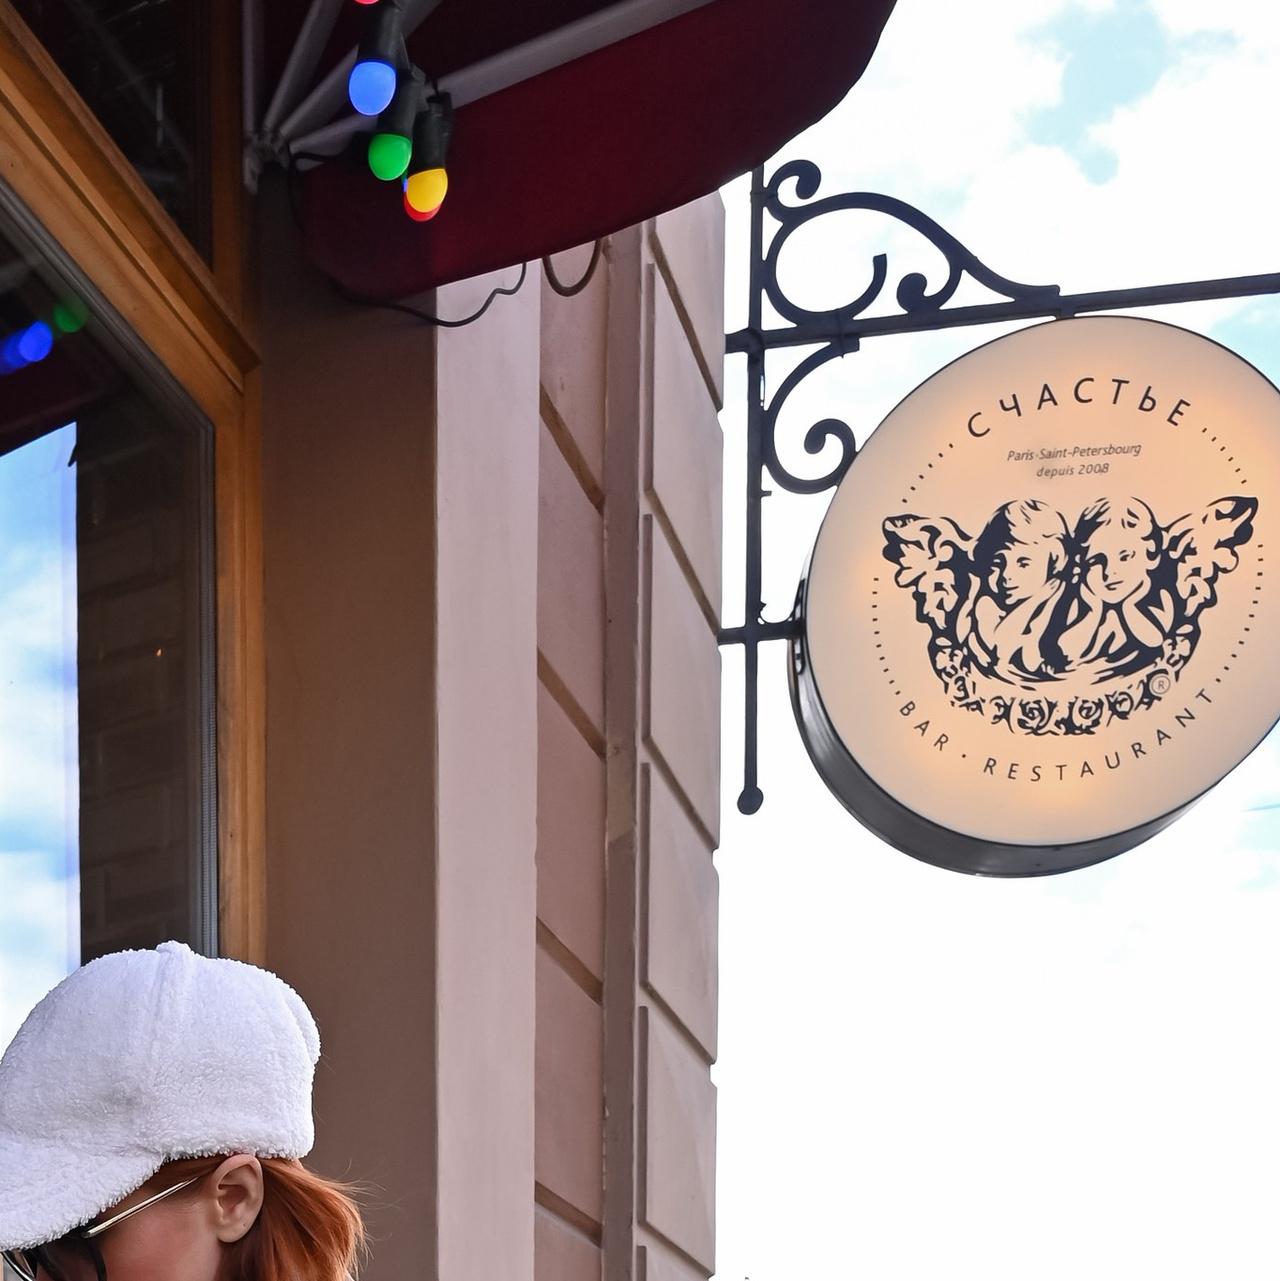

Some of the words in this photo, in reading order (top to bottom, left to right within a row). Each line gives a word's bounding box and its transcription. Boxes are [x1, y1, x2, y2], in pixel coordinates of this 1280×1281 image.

[967, 377, 1191, 437] СЧАСТЬЕ
[1036, 465, 1074, 479] depuis
[1078, 463, 1109, 475] 2008
[899, 701, 949, 751] BAR
[983, 688, 1212, 782] RESTAURANT
